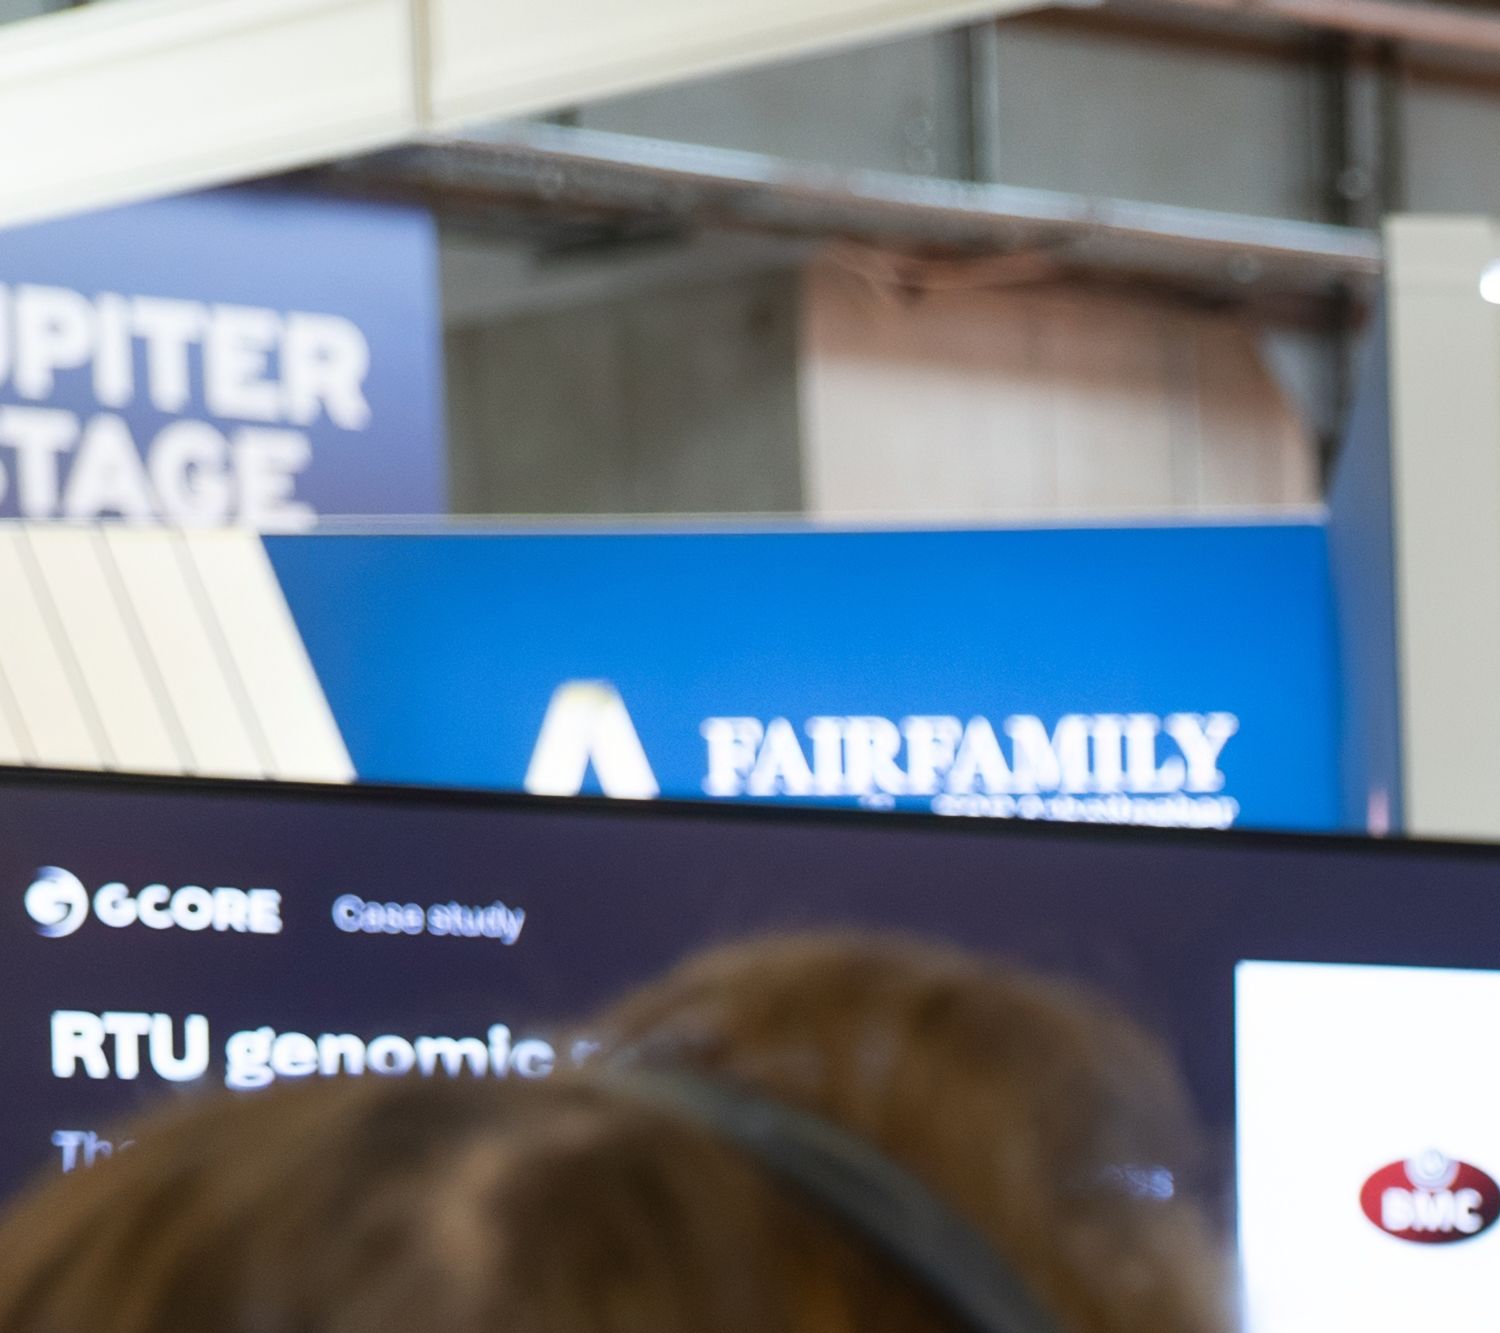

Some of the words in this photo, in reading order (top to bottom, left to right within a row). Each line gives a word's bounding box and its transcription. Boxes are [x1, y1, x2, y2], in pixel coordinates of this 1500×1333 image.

[0, 284, 371, 431] PITER
[0, 404, 318, 530] TAGE
[700, 712, 1240, 796] FAIRFAMILY
[93, 882, 283, 934] GCORE
[50, 1009, 210, 1082] RTU
[224, 1023, 556, 1091] genomic
